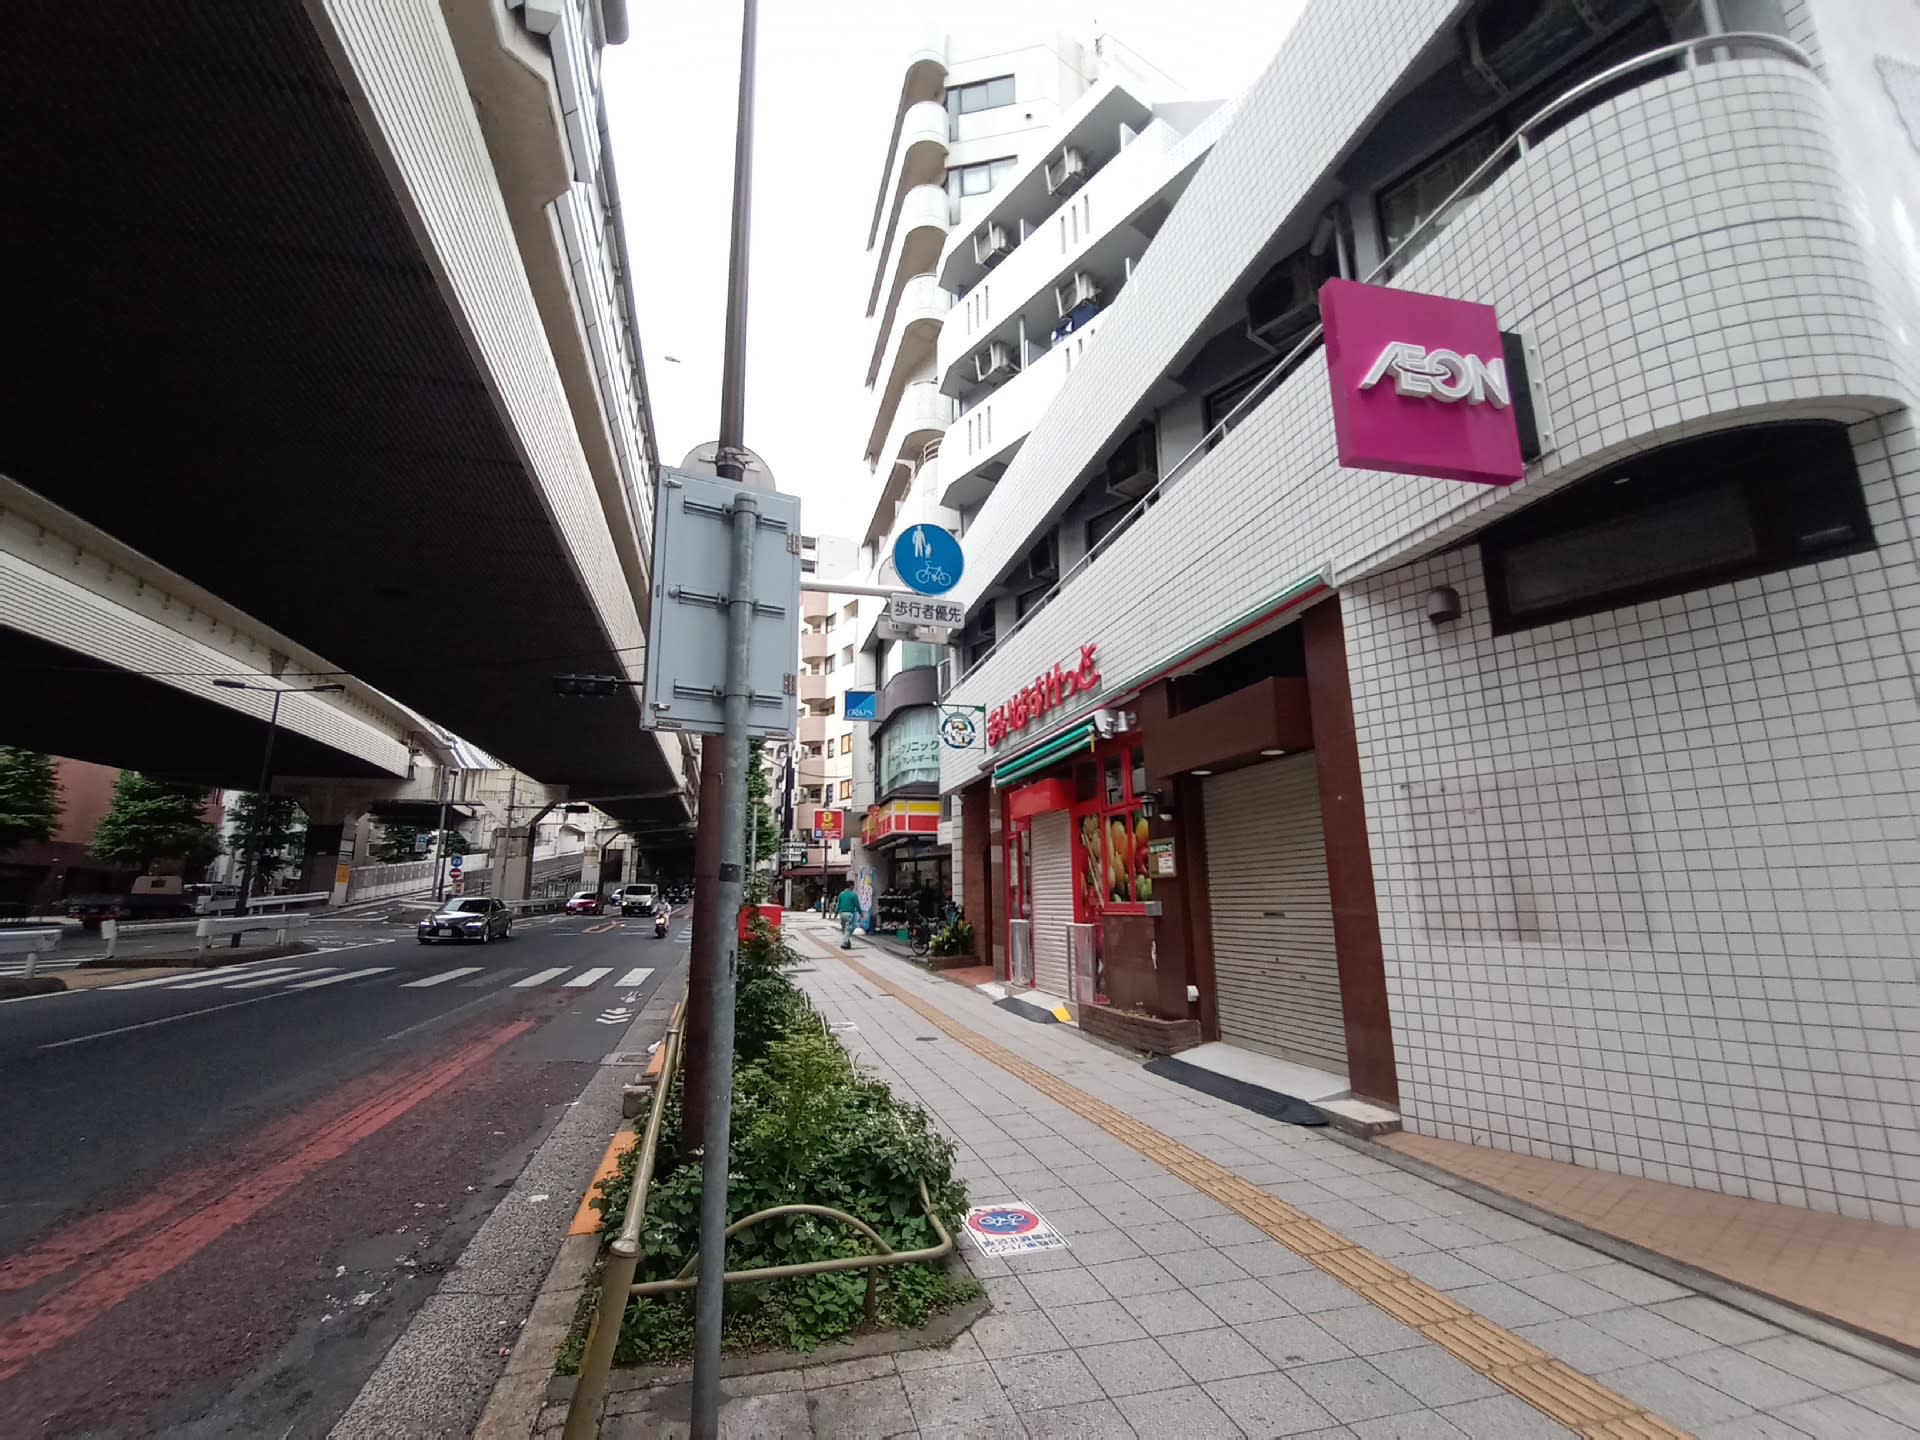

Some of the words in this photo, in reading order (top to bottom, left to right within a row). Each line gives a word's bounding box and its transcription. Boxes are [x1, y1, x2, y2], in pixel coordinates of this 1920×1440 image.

[1359, 341, 1510, 409] AEON
[895, 601, 961, 622] 歩行者優先
[988, 643, 1102, 748] まいばすけっと
